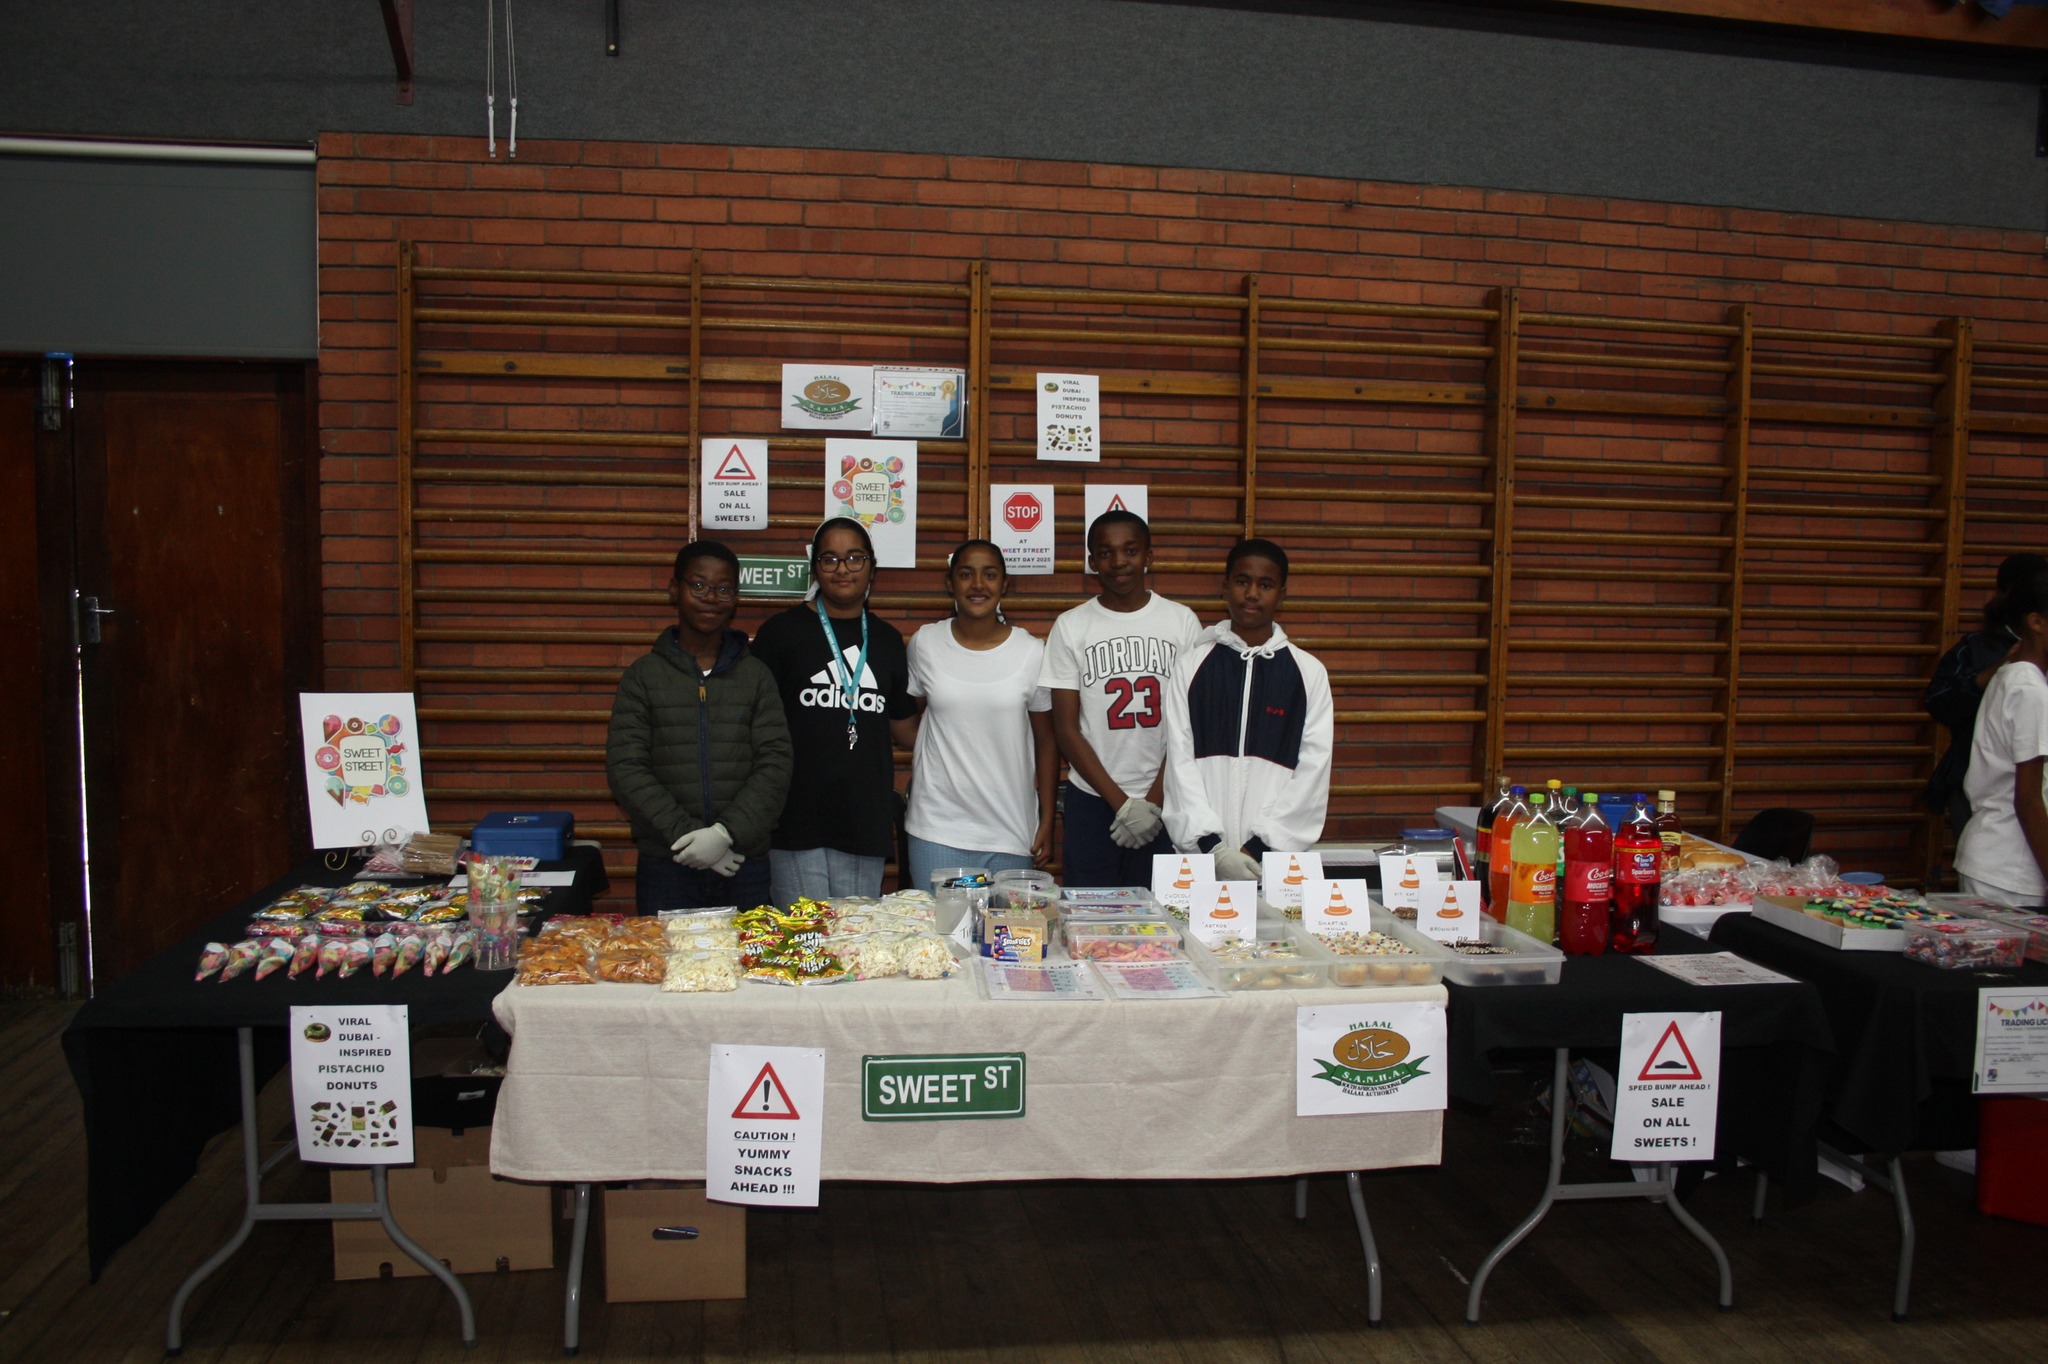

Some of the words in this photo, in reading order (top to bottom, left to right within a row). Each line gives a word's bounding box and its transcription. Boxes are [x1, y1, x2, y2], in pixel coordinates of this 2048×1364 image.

[855, 482, 886, 492] SWEET
[855, 493, 887, 502] STREET
[1007, 506, 1039, 519] STOP
[739, 567, 783, 585] WEET
[787, 564, 804, 578] ST
[1083, 636, 1177, 687] JORDAN
[799, 683, 886, 714] adidas
[1104, 676, 1162, 730] 23
[343, 748, 381, 758] SWEET
[345, 761, 384, 771] STREET
[1631, 868, 1656, 876] Sparberry
[338, 1018, 372, 1026] VIRAL
[1348, 1020, 1393, 1031] HALAAL
[2000, 1018, 2035, 1027] TRADING
[339, 1033, 374, 1041] DUBAI
[339, 1048, 392, 1057] INSPIRED
[318, 1064, 385, 1073] PISTACHIO
[1341, 1070, 1405, 1083] S.A.N.H.A.
[326, 1081, 378, 1090] DONUTS
[879, 1073, 976, 1105] SWEET
[983, 1065, 1012, 1089] ST
[1341, 1087, 1364, 1096] HALAAL
[1365, 1087, 1399, 1096] AUTHORITY
[1651, 1097, 1685, 1108] SALE
[1643, 1118, 1662, 1127] ON
[1666, 1117, 1690, 1127] ALL
[734, 1131, 789, 1141] CAUTION
[1634, 1137, 1688, 1147] SWEETS
[738, 1148, 791, 1159] YUMMY
[734, 1165, 792, 1177] SNACKS
[730, 1182, 778, 1194] AHEAD
[782, 1184, 795, 1194] !!!
